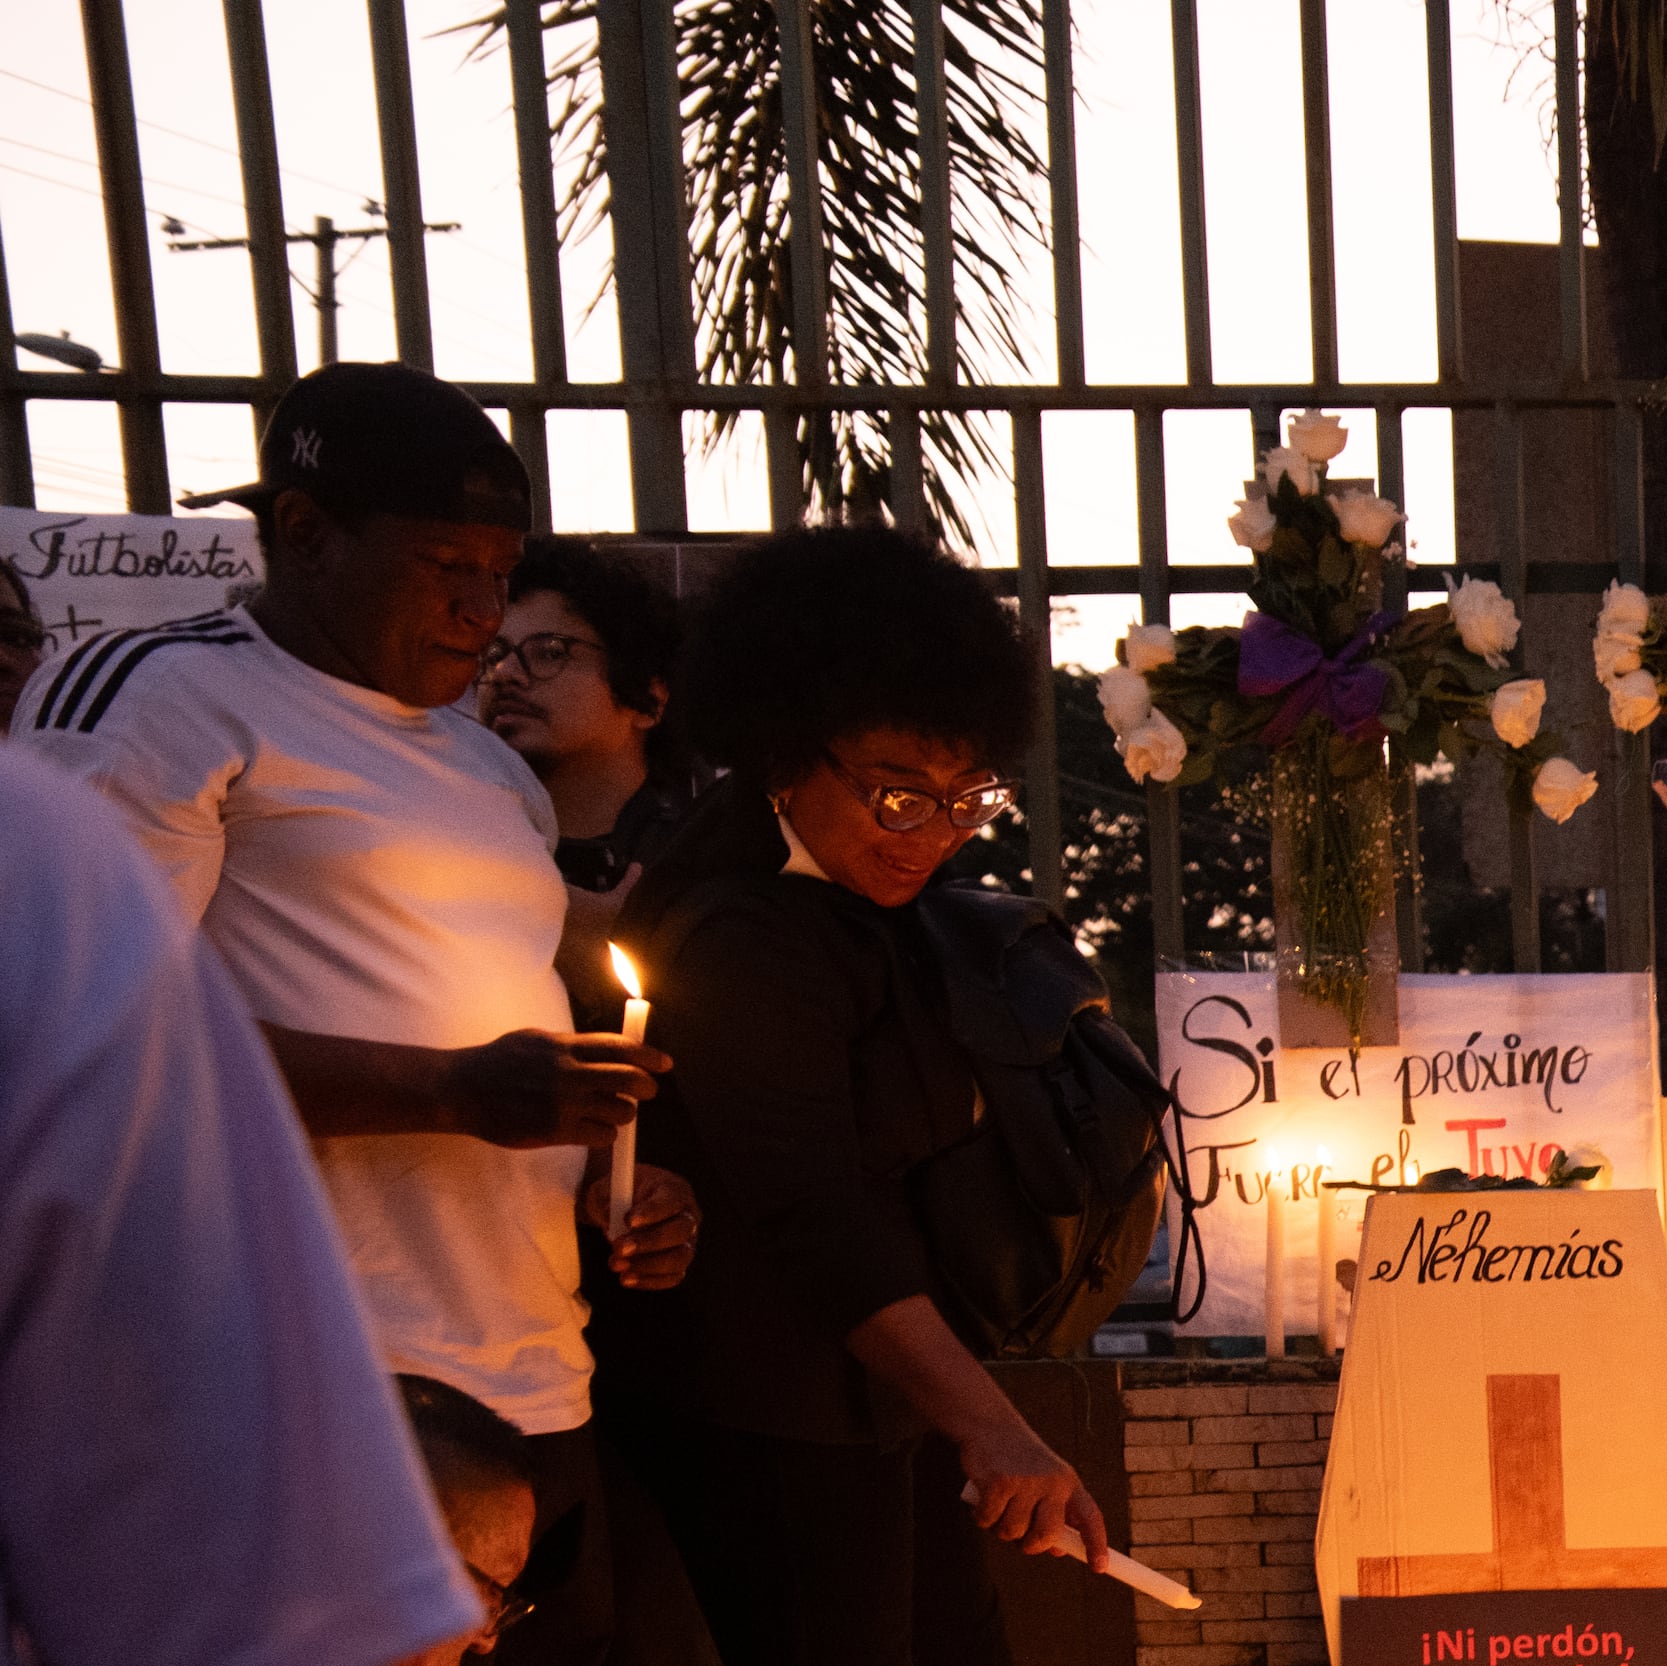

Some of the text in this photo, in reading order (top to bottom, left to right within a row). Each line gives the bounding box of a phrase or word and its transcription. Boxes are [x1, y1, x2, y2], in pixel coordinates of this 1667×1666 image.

[1170, 995, 1280, 1120] Si
[1320, 1046, 1361, 1100] el
[1421, 1624, 1635, 1666] ¡Ni perdón,
